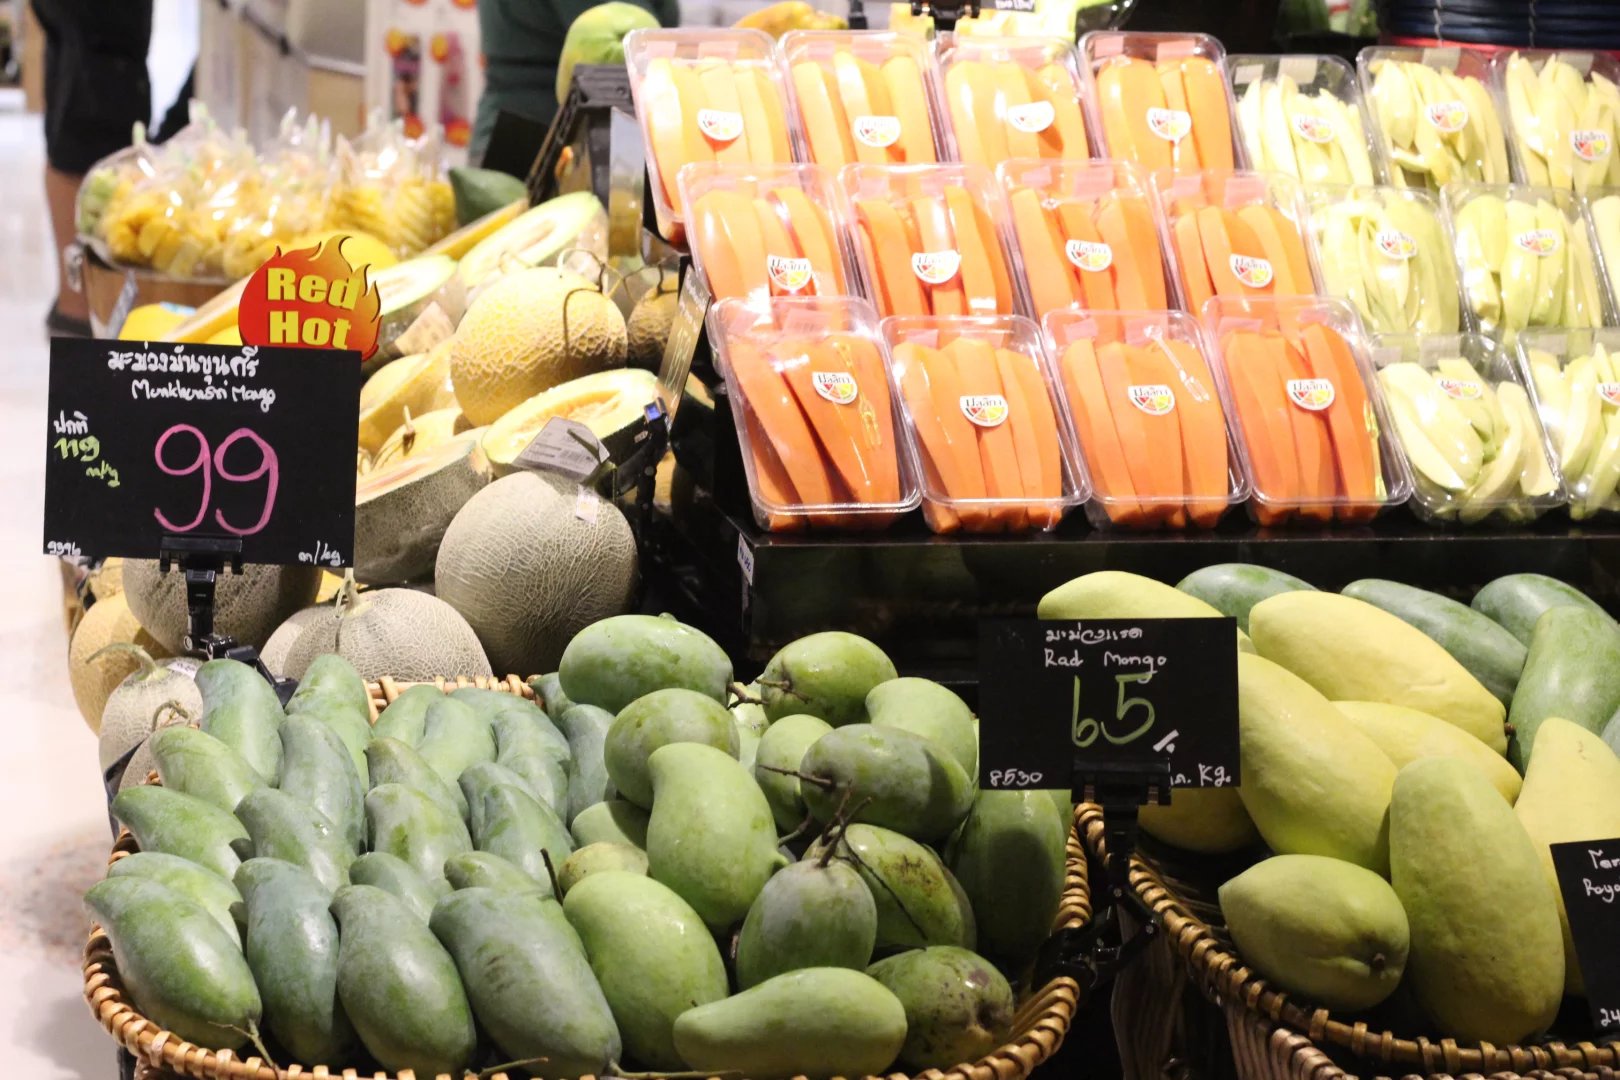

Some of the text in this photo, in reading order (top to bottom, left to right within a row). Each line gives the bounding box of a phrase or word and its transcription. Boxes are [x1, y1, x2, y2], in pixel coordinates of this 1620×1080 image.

[267, 267, 361, 310] Red
[269, 310, 352, 350] Hot
[154, 423, 279, 536] 99
